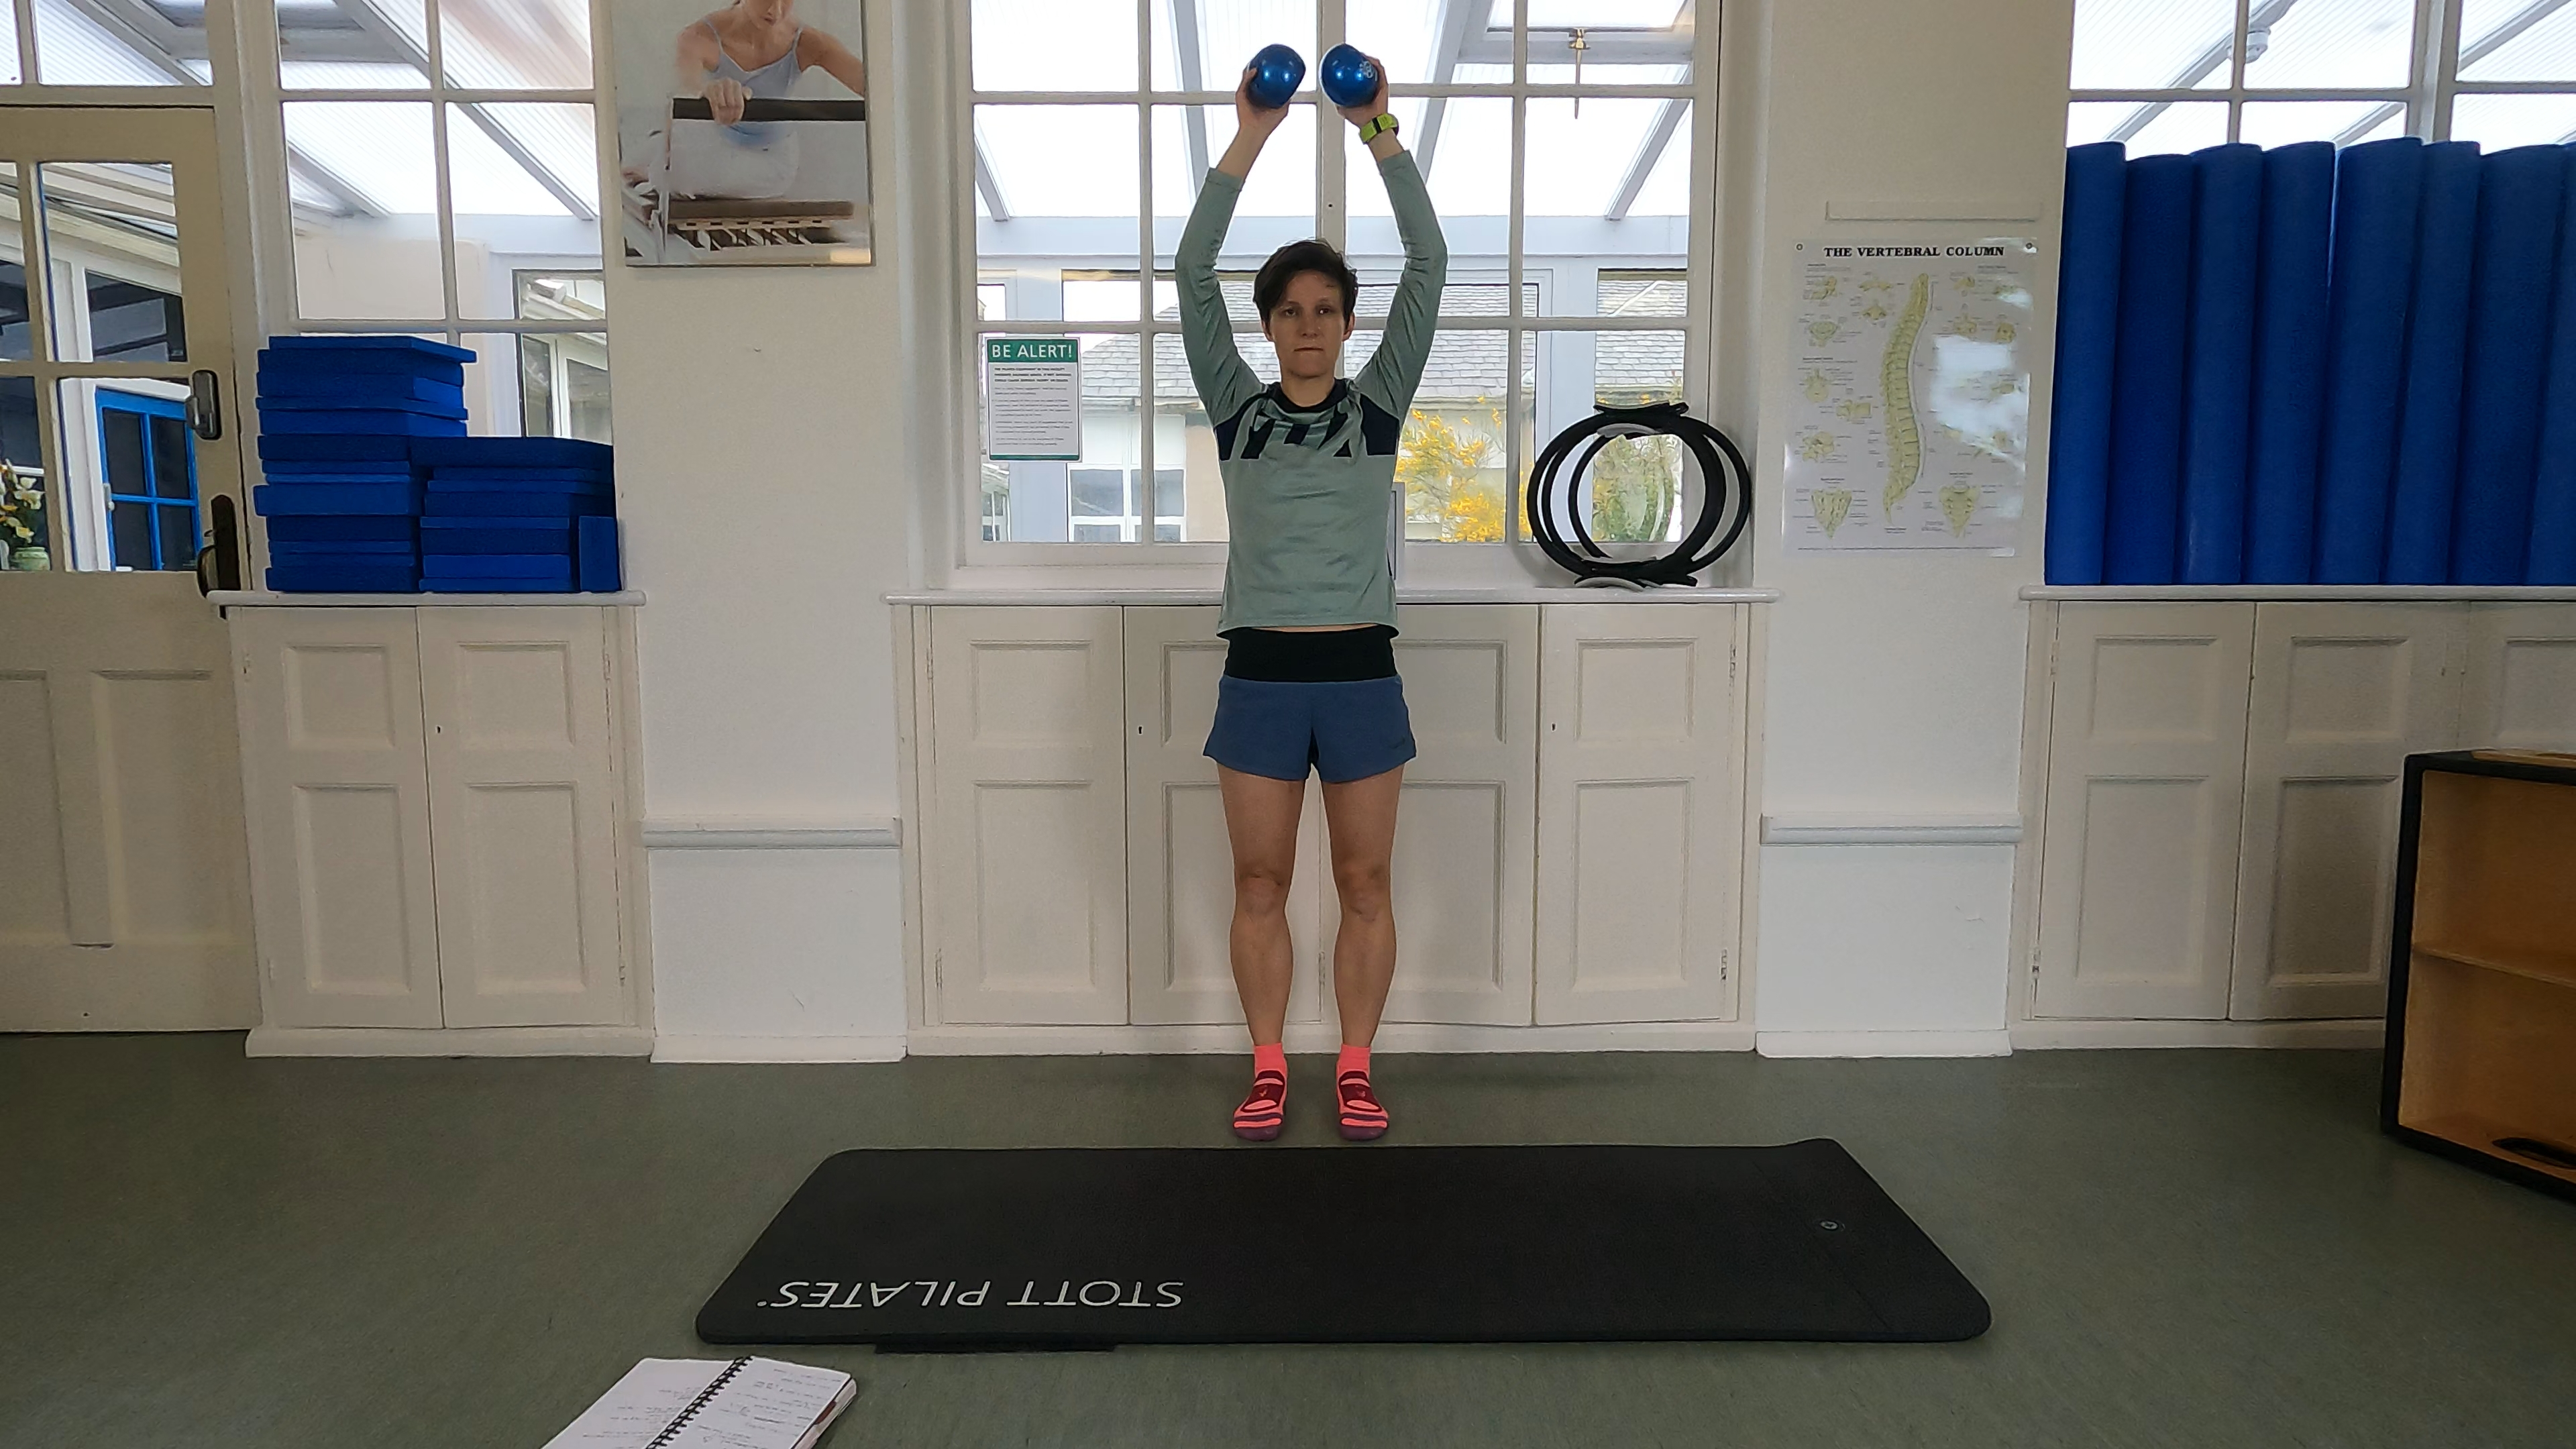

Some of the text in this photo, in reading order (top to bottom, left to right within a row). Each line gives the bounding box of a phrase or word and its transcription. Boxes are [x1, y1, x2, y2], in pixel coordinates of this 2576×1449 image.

[1824, 247, 2004, 257] THE VERTEBRAL COLUMN
[992, 344, 1072, 358] BE ALERT!
[770, 1281, 1183, 1307] STOTT PILATES
